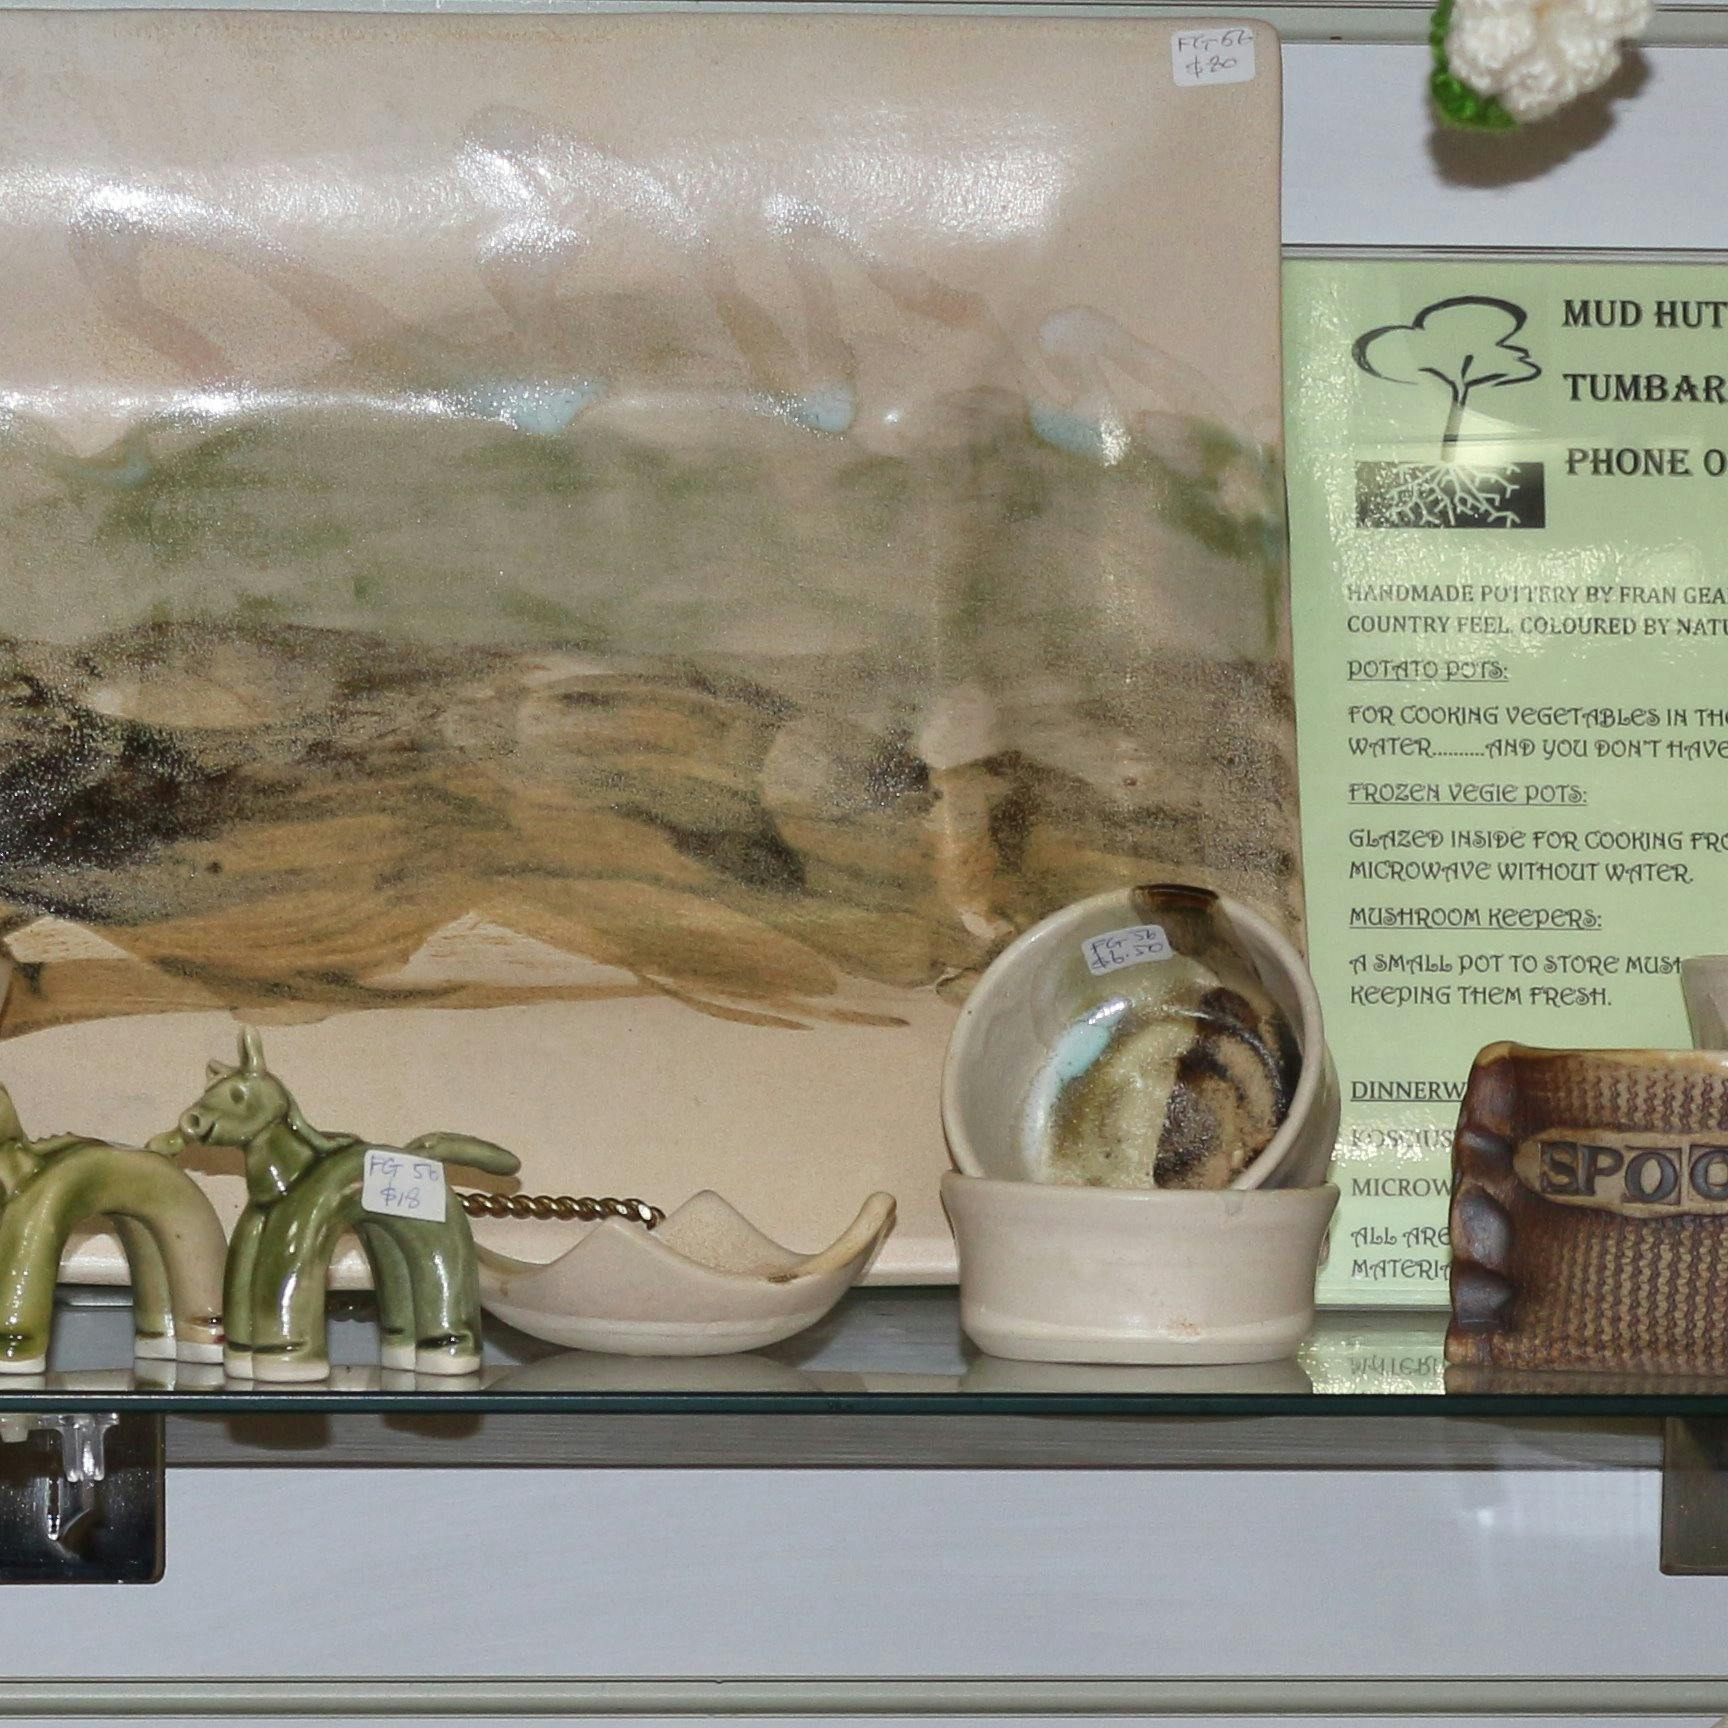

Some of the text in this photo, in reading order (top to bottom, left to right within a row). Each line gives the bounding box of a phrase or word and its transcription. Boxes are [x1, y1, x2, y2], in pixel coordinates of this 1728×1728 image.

[1562, 300, 1643, 327] MUD
[1655, 300, 1728, 328] HUT
[1567, 448, 1693, 476] PHONE
[1347, 584, 1473, 602] HANDMADE
[1480, 585, 1579, 603] POTTERY
[1586, 586, 1613, 603] BY
[1621, 586, 1676, 604] FRAN
[1347, 616, 1449, 633] COUNTRY
[1520, 617, 1636, 635] COLOURED
[1644, 618, 1670, 635] BY
[1347, 660, 1508, 681] POTATO POTS:
[1348, 706, 1395, 725] FOR
[1400, 706, 1498, 726] COOKING
[1505, 707, 1660, 728] VEGETABLES
[1666, 708, 1687, 727] IN
[1543, 739, 1588, 760] YOU
[1594, 739, 1661, 757] DON'T
[1348, 783, 1587, 804] FROZEN VEGIE POTS:
[1349, 829, 1443, 849] GLAZED
[1451, 830, 1526, 849] INSIDE
[1532, 830, 1579, 851] FOR
[1585, 830, 1683, 851] COOKING
[1349, 860, 1694, 884] MICROWAVE WITHOUT WATER.
[1349, 907, 1603, 929] MUSHROOM KEEPERS:
[1349, 954, 1368, 975] A
[1373, 955, 1452, 974] SMALL
[1459, 955, 1504, 976] POT
[1509, 956, 1537, 974] TO
[1543, 956, 1620, 976] STORE
[1350, 986, 1612, 1008] KEEPING THEM FRESH.
[1351, 1081, 1467, 1101] DINNERW
[1352, 1129, 1456, 1148] KOSCIUS
[380, 1182, 421, 1209] $18
[1352, 1178, 1452, 1197] MICROW
[1351, 1226, 1450, 1247] ALL ARE
